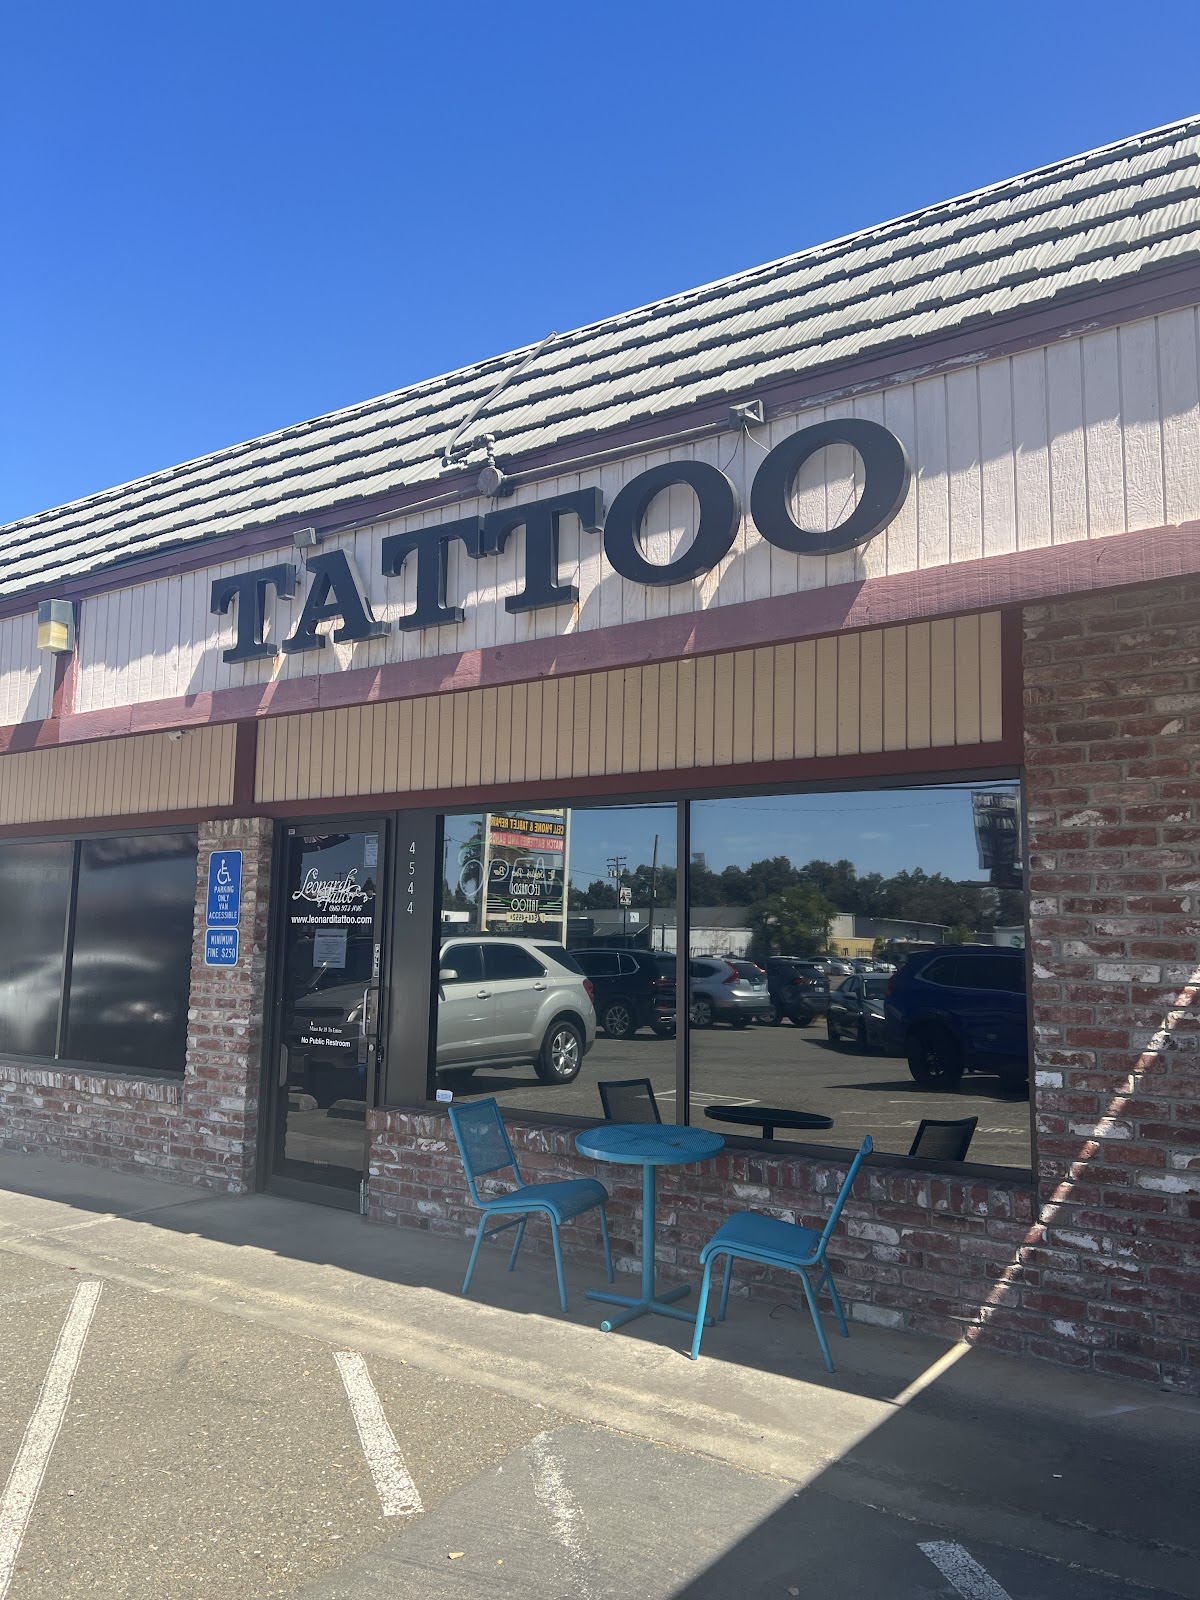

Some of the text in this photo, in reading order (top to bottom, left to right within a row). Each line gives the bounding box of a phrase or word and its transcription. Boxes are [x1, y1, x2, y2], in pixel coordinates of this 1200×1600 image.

[210, 418, 911, 664] TATTOO
[407, 841, 416, 914] 4544
[214, 885, 234, 894] PARKING
[292, 868, 361, 902] Leonardi
[217, 894, 230, 902] ONLY
[218, 902, 229, 910] VAN
[208, 911, 238, 919] ACCESSIBLE
[291, 914, 372, 924] www.leonarditattoo.com
[210, 935, 233, 945] MINIMUM
[207, 947, 236, 958] FINE $250
[301, 1036, 351, 1048] No Public Restroom
